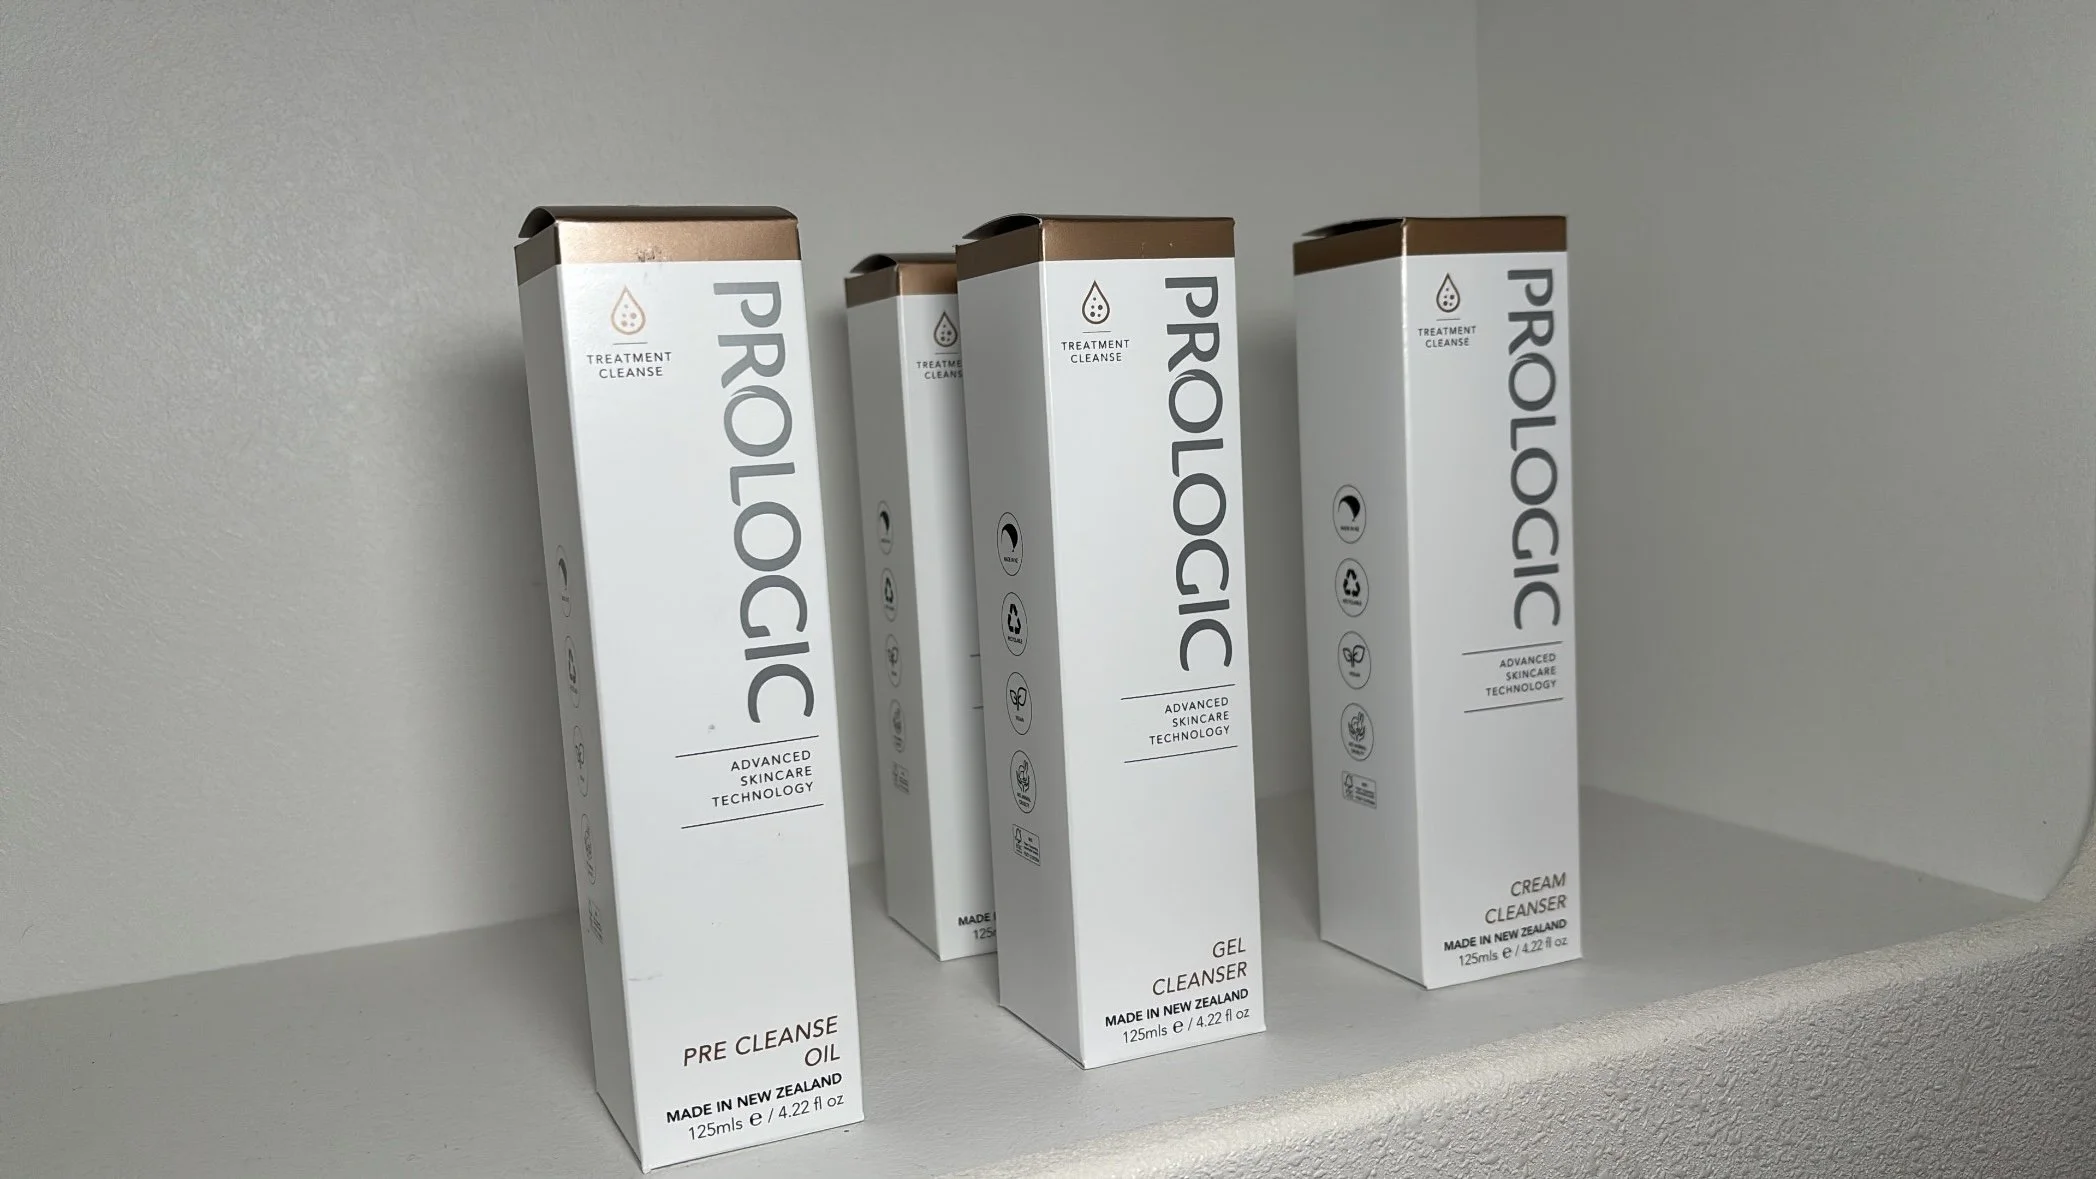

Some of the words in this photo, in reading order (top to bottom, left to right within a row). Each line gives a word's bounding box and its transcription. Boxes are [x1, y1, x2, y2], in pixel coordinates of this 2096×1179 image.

[1417, 325, 1477, 337] TREATMENT
[1061, 338, 1130, 351] TREATMENT
[1425, 337, 1470, 349] CLEANSE
[587, 352, 672, 366] TREATMENT
[916, 359, 962, 369] TREATME
[1070, 352, 1122, 363] CLEANSE
[599, 366, 663, 379] CLEANSE
[924, 369, 963, 380] CLEANS
[1507, 268, 1561, 630] PROLOGIC
[1164, 276, 1233, 671] PROLOGIC
[713, 281, 815, 724] PROLOGIC
[1499, 653, 1556, 668] ADVANCED
[1505, 666, 1557, 681] SKINCARE
[1485, 680, 1557, 697] TECHNOLOGY
[1164, 697, 1229, 714] ADVANCED
[1172, 711, 1230, 728] SKINCARE
[1149, 725, 1230, 745] TECHNOLOGY
[730, 750, 811, 772] ADVANCED
[740, 766, 813, 787] SKINCARE
[712, 781, 813, 807] TECHNOLOGY
[1510, 872, 1566, 897] CREAM
[958, 912, 991, 926] MADE
[1485, 894, 1567, 924] CLEANSER
[1443, 937, 1477, 952] MADE
[1479, 934, 1491, 946] IN
[1494, 929, 1519, 943] NEW
[1521, 918, 1567, 938] ZEALAND
[1212, 937, 1246, 958] GEL
[1459, 949, 1499, 967] 125mls
[1522, 939, 1544, 954] 4.22
[1554, 936, 1568, 947] oz
[1152, 961, 1248, 996] CLEANSER
[1105, 1011, 1143, 1027] MADE
[1146, 1007, 1160, 1020] IN
[1163, 1001, 1192, 1016] NEW
[1195, 988, 1249, 1010] ZEALAND
[1122, 1024, 1168, 1044] 125mls
[1196, 1011, 1222, 1028] 4.22
[1225, 1009, 1232, 1022] fl
[1236, 1008, 1250, 1020] oz
[683, 1041, 727, 1067] PRE
[735, 1015, 838, 1055] CLEANSE
[804, 1043, 840, 1067] OIL
[666, 1103, 712, 1123] MADE
[716, 1099, 732, 1113] IN
[737, 1090, 772, 1108] NEW
[776, 1072, 842, 1099] ZEALAND
[688, 1117, 743, 1140] 125mls
[778, 1100, 810, 1120] 4.22
[814, 1096, 822, 1111] fl
[827, 1095, 844, 1107] oz
